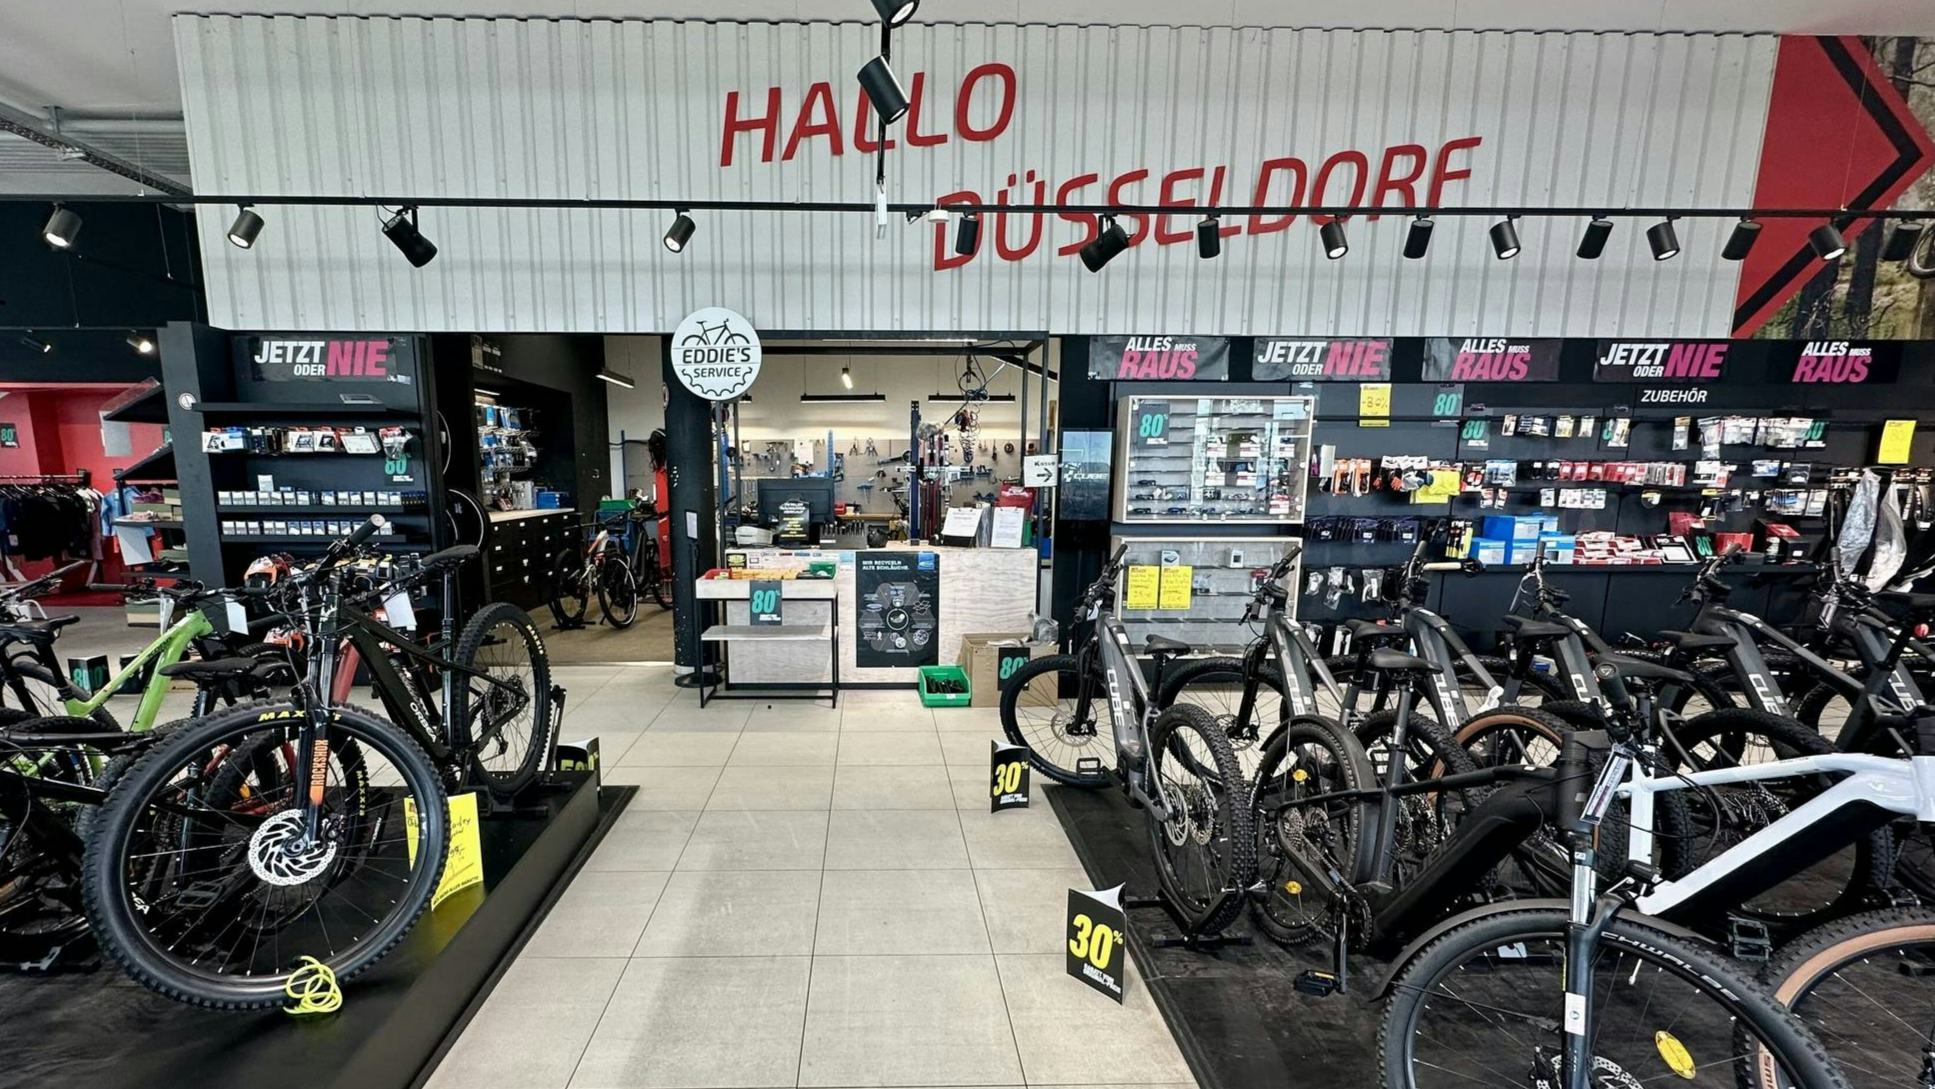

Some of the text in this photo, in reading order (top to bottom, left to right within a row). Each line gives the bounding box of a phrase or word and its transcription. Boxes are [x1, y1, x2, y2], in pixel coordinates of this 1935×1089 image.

[720, 62, 1017, 168] HALLO
[933, 136, 1483, 272] DÜSSELDORF
[254, 340, 390, 376] JETZT NIE
[682, 347, 751, 365] EDDIE'S
[1124, 337, 1197, 352] ALLES MUSS
[1257, 341, 1388, 376] JETZT NIE
[1459, 338, 1530, 354] ALLES MUSS
[1599, 343, 1729, 378] JETZT NIE
[1801, 341, 1873, 357] ALLES MUSS
[293, 364, 326, 376] ODER
[693, 367, 742, 379] SERVICE
[1117, 350, 1199, 379] RAUS
[1291, 363, 1325, 376] ODER
[1450, 352, 1532, 381] RAUS
[1632, 365, 1665, 378] ODER
[1791, 355, 1873, 383] RAUS
[1640, 387, 1708, 403] ZUBEHÖR
[1106, 668, 1125, 728] CUBE
[1286, 673, 1307, 717] CUB
[1432, 672, 1460, 728] CUBE
[1570, 673, 1592, 704] CU
[1748, 673, 1783, 716] CUB
[409, 701, 437, 743] ORBEA
[310, 739, 329, 787] ROCKSHOX
[993, 761, 1029, 797] 30%
[1069, 914, 1124, 970] 30%
[1600, 930, 1741, 1001] CHWALBE
